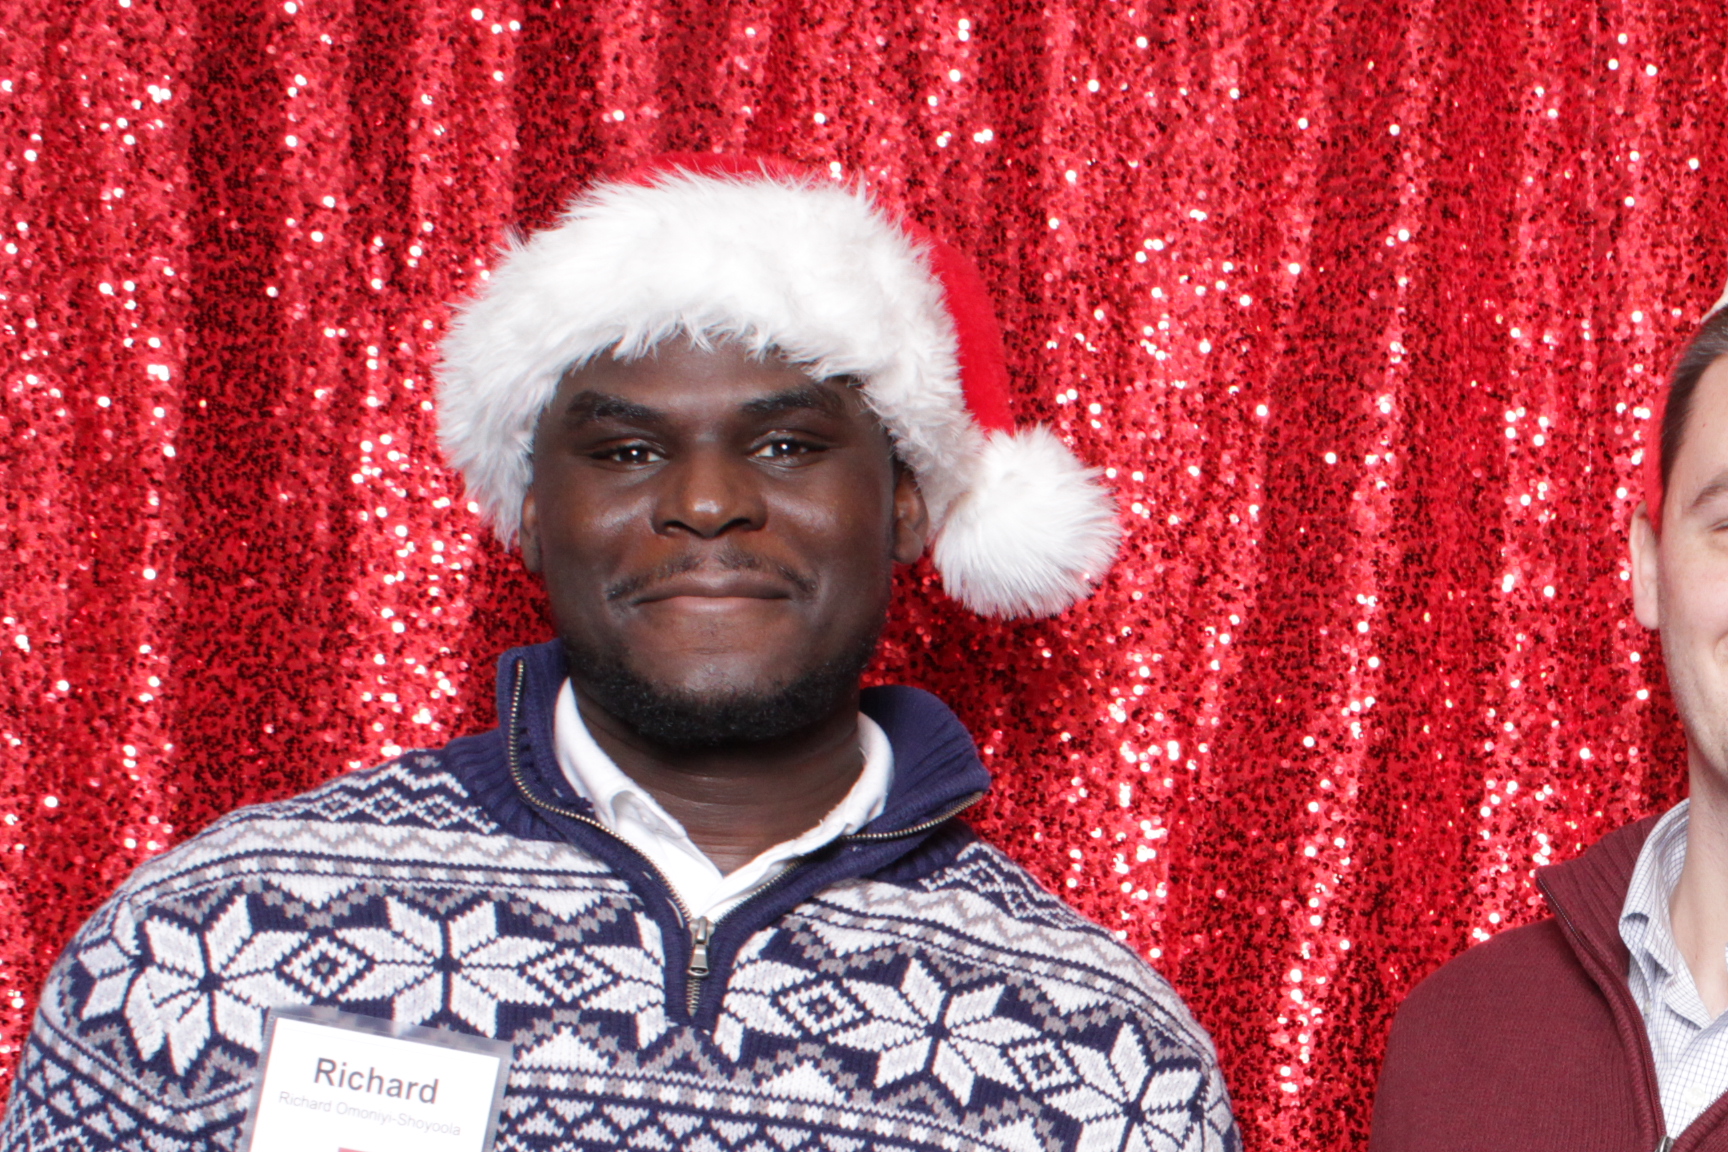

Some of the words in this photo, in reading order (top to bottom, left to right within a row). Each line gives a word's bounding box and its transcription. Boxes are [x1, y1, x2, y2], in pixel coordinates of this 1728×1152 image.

[314, 1057, 439, 1105] Richard
[278, 1090, 332, 1113] Richard
[336, 1101, 462, 1136] Omoniyi-Shoyoola
